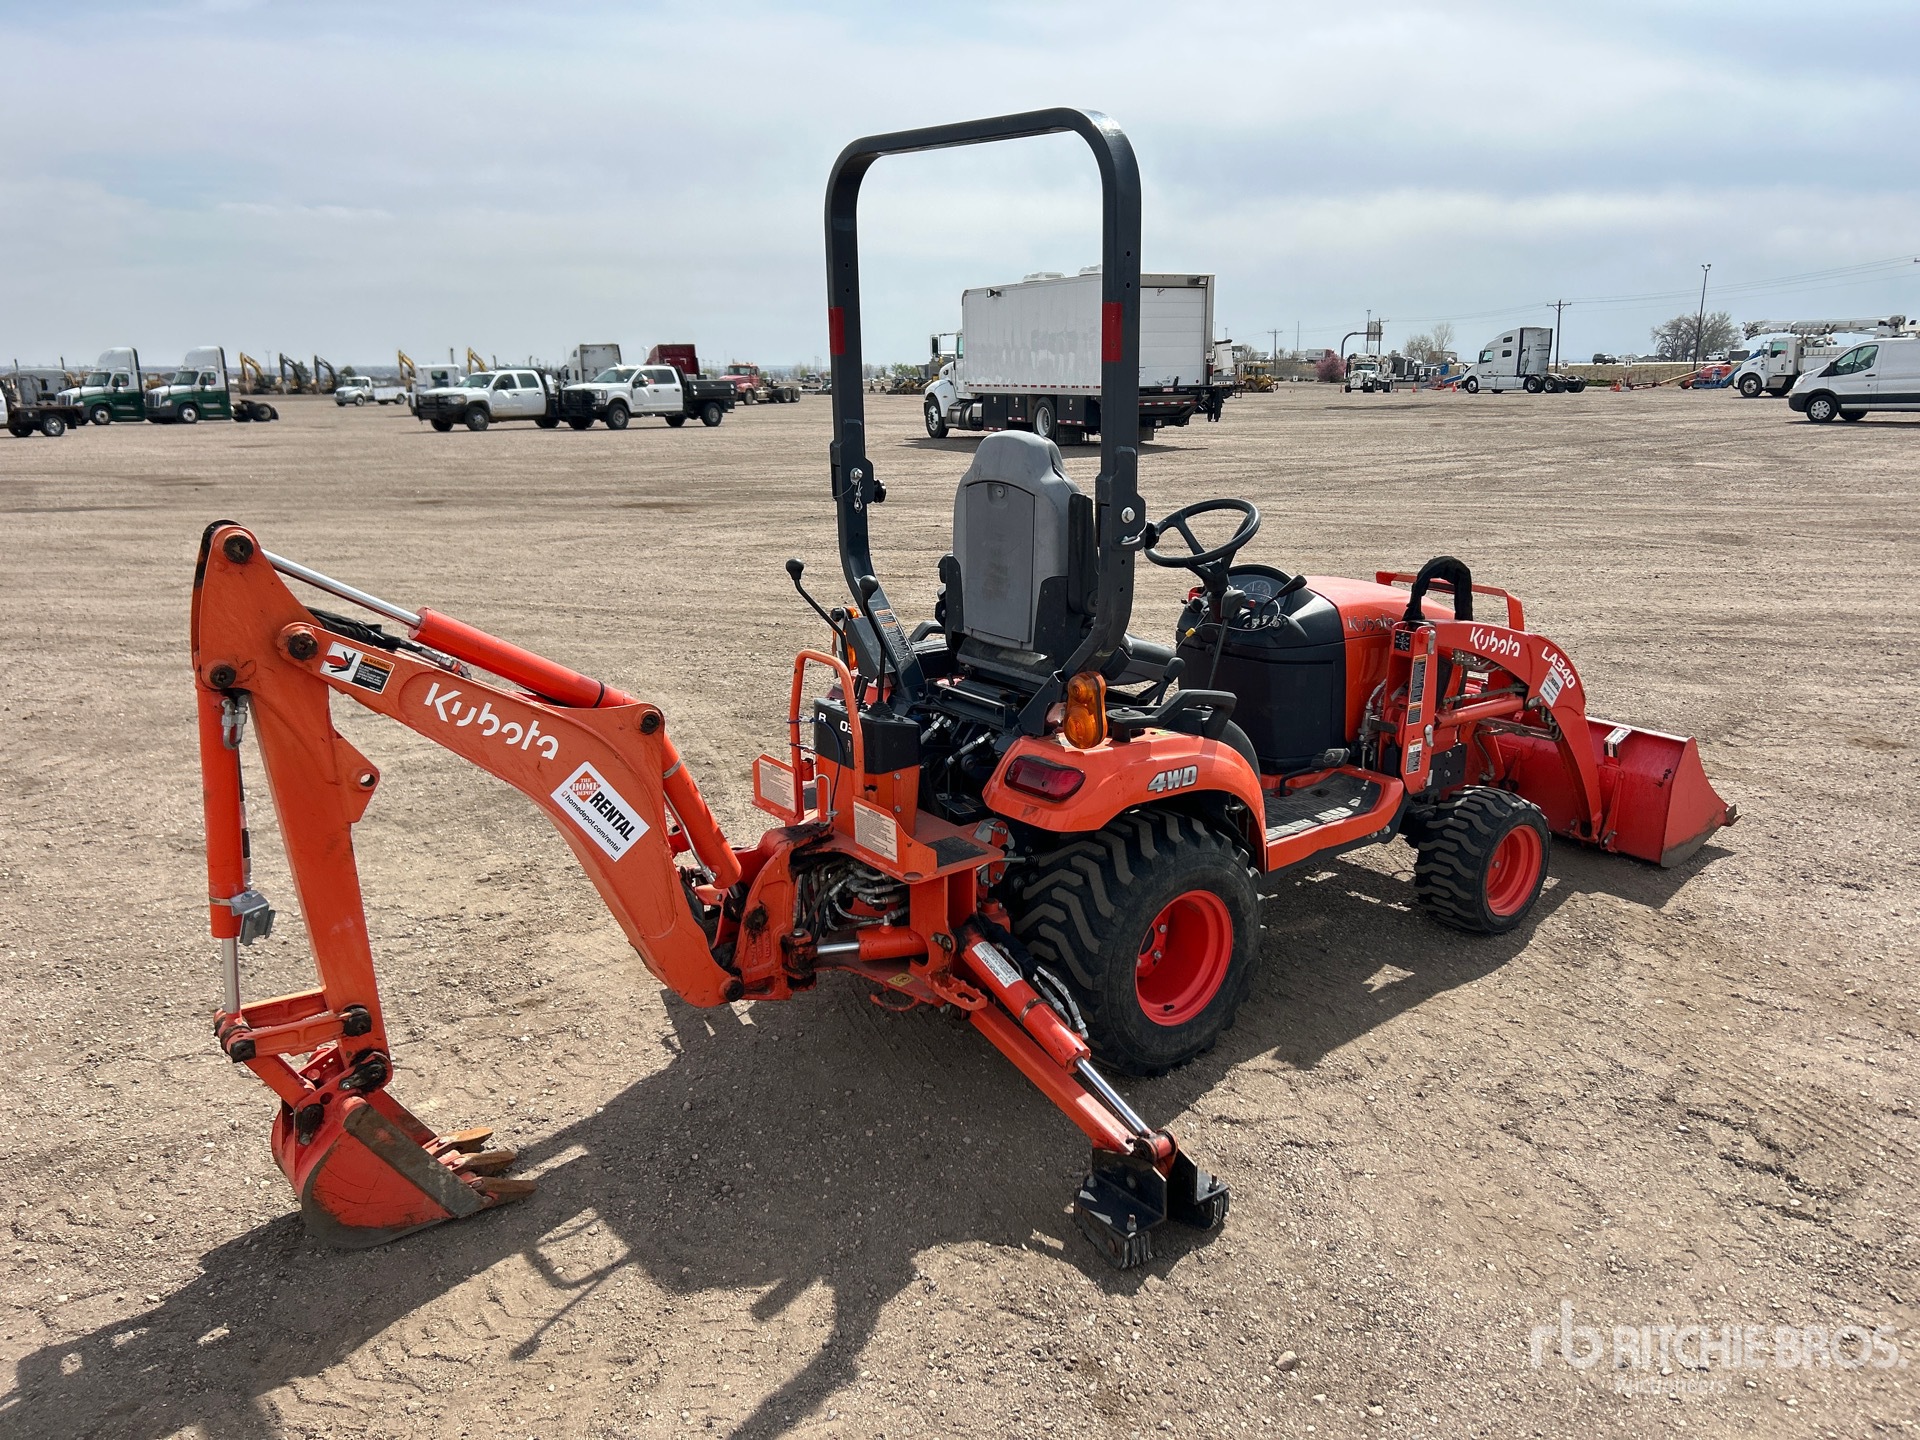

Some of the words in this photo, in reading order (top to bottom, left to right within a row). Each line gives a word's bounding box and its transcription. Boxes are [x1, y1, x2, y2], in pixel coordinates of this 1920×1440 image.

[1470, 626, 1521, 657] Kubota
[1541, 646, 1576, 689] LA340
[424, 682, 559, 760] Kubota
[572, 782, 599, 791] HOME
[1147, 764, 1198, 793] 4WD
[564, 795, 621, 852] homedepot.com/rental
[589, 791, 635, 841] RENTAL
